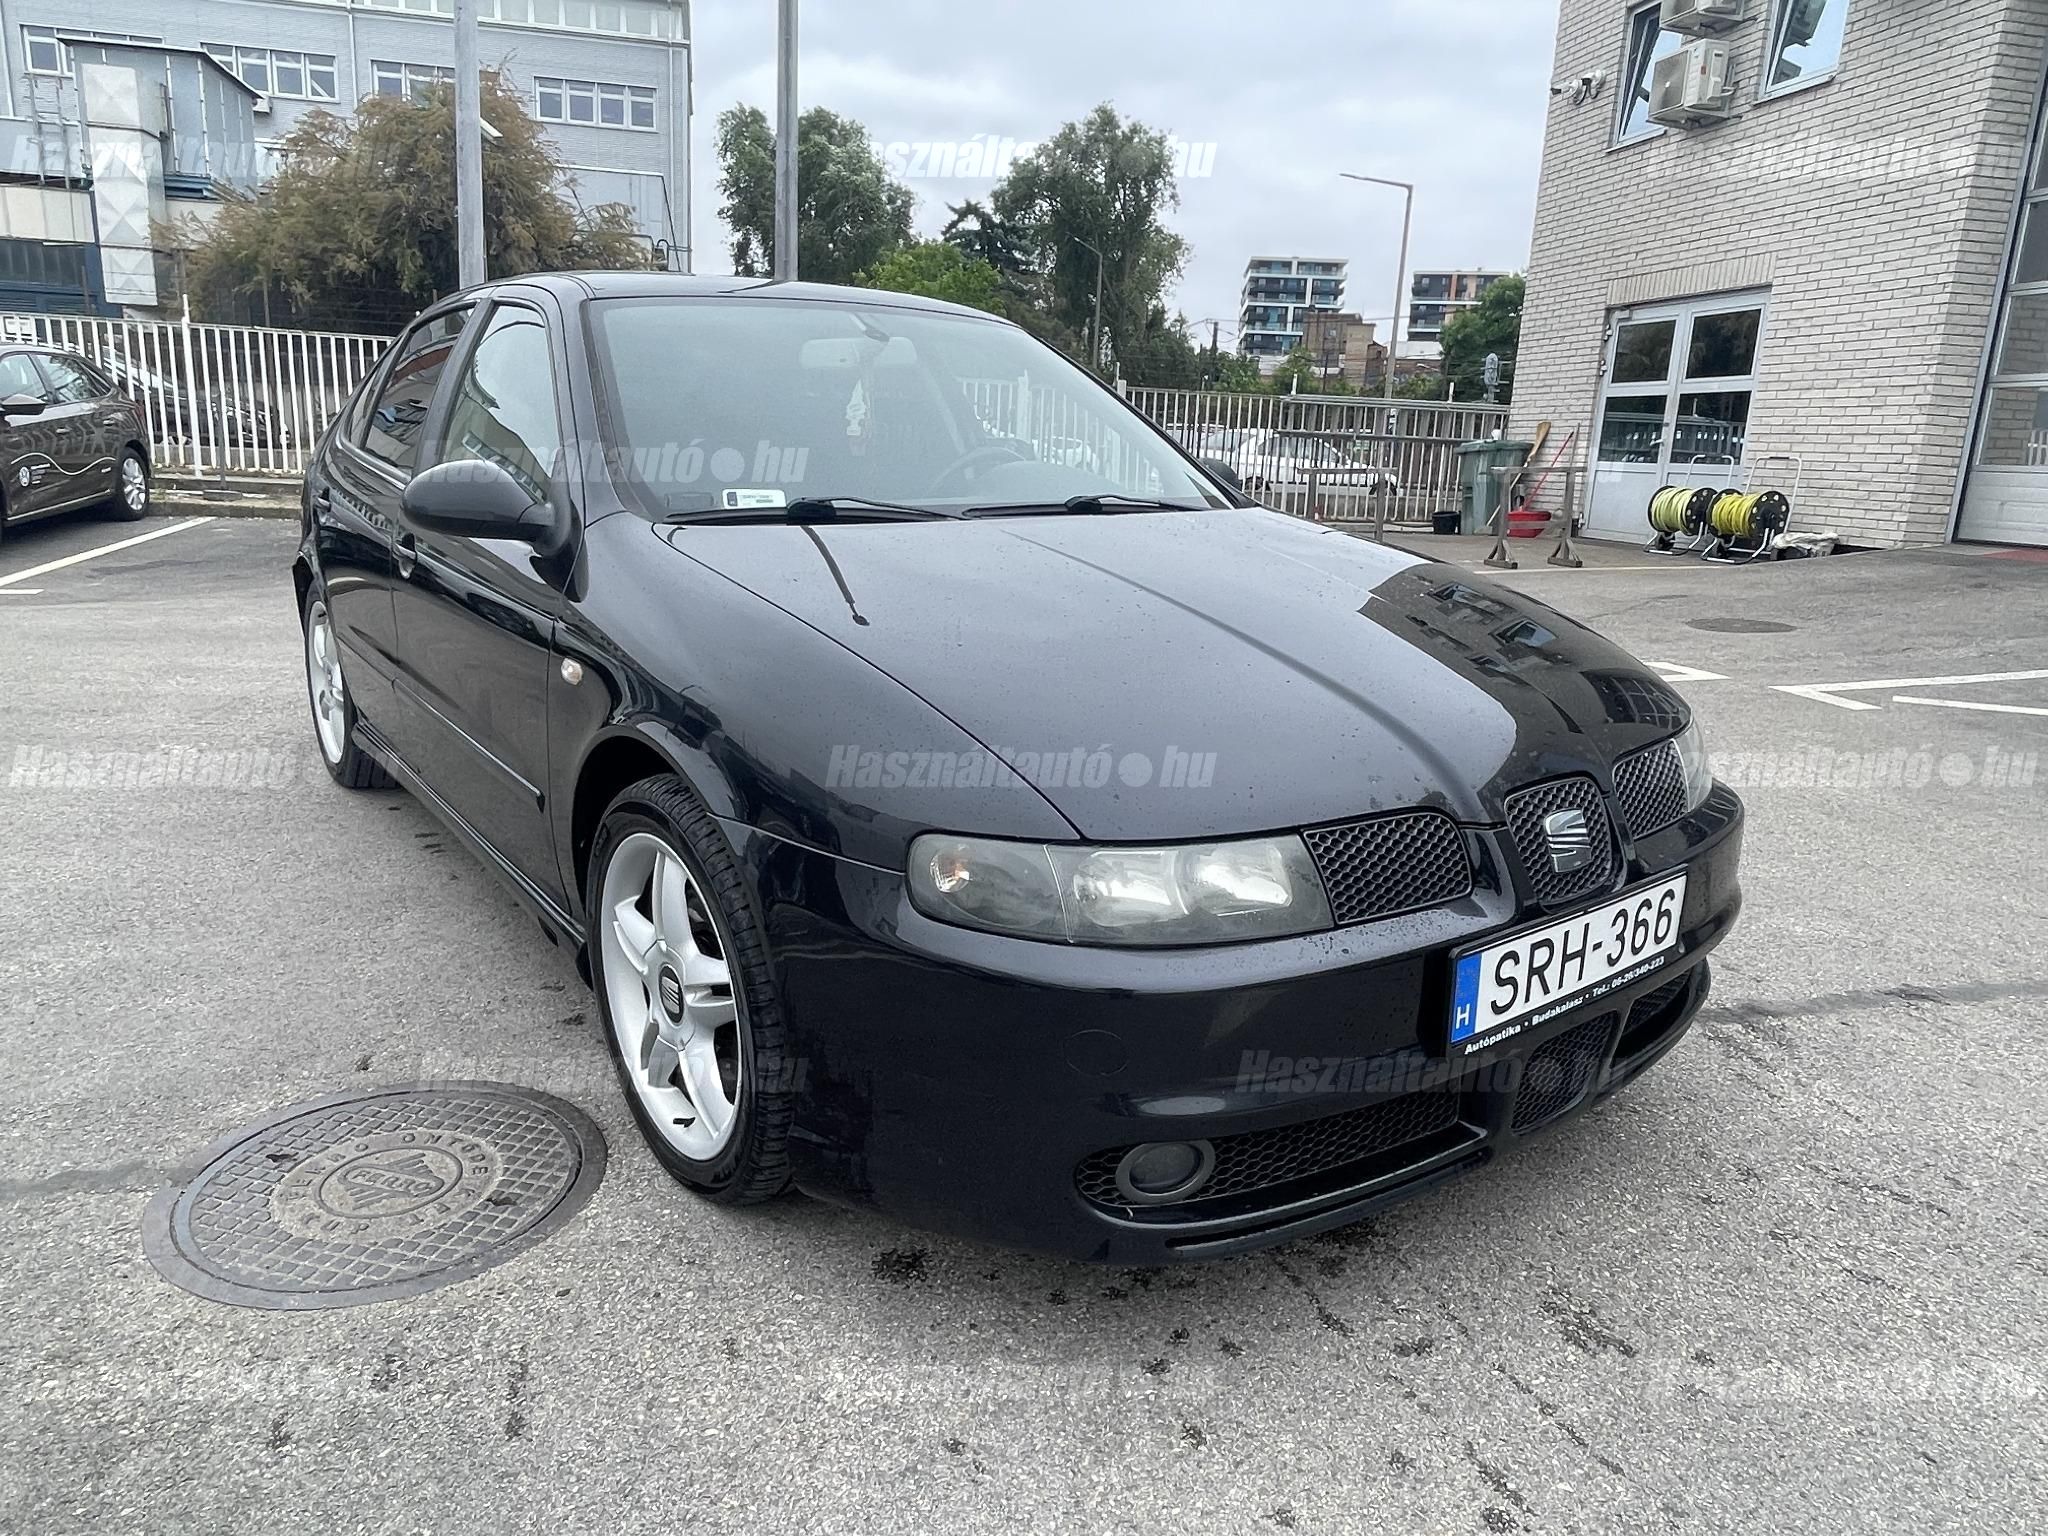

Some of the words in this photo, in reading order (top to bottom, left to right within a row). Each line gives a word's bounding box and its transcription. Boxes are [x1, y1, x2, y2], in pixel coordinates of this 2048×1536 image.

[1490, 887, 1676, 1016] SRH-366
[1455, 1003, 1471, 1030] H
[1463, 1022, 1522, 1055] Autópatika
